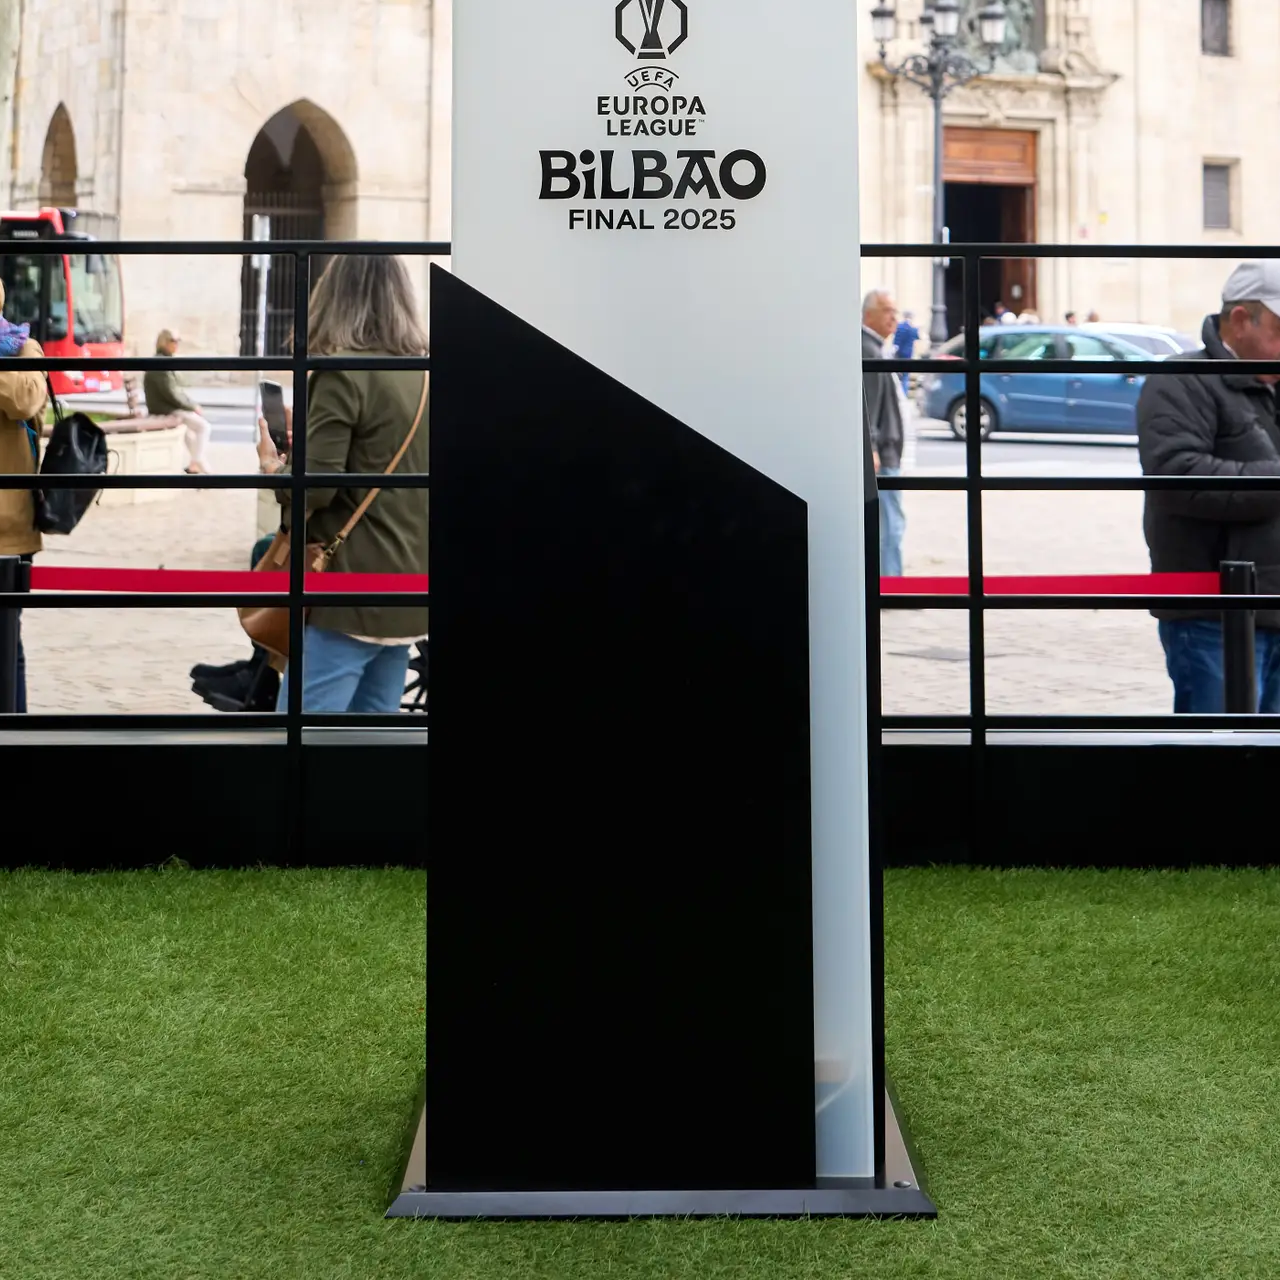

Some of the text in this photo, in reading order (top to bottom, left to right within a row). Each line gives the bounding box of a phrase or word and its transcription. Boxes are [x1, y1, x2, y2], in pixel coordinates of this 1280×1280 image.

[627, 71, 674, 88] UEFA
[597, 96, 706, 115] EUROPA
[607, 119, 696, 136] LEAGUE
[569, 208, 736, 230] FINAL 2025
